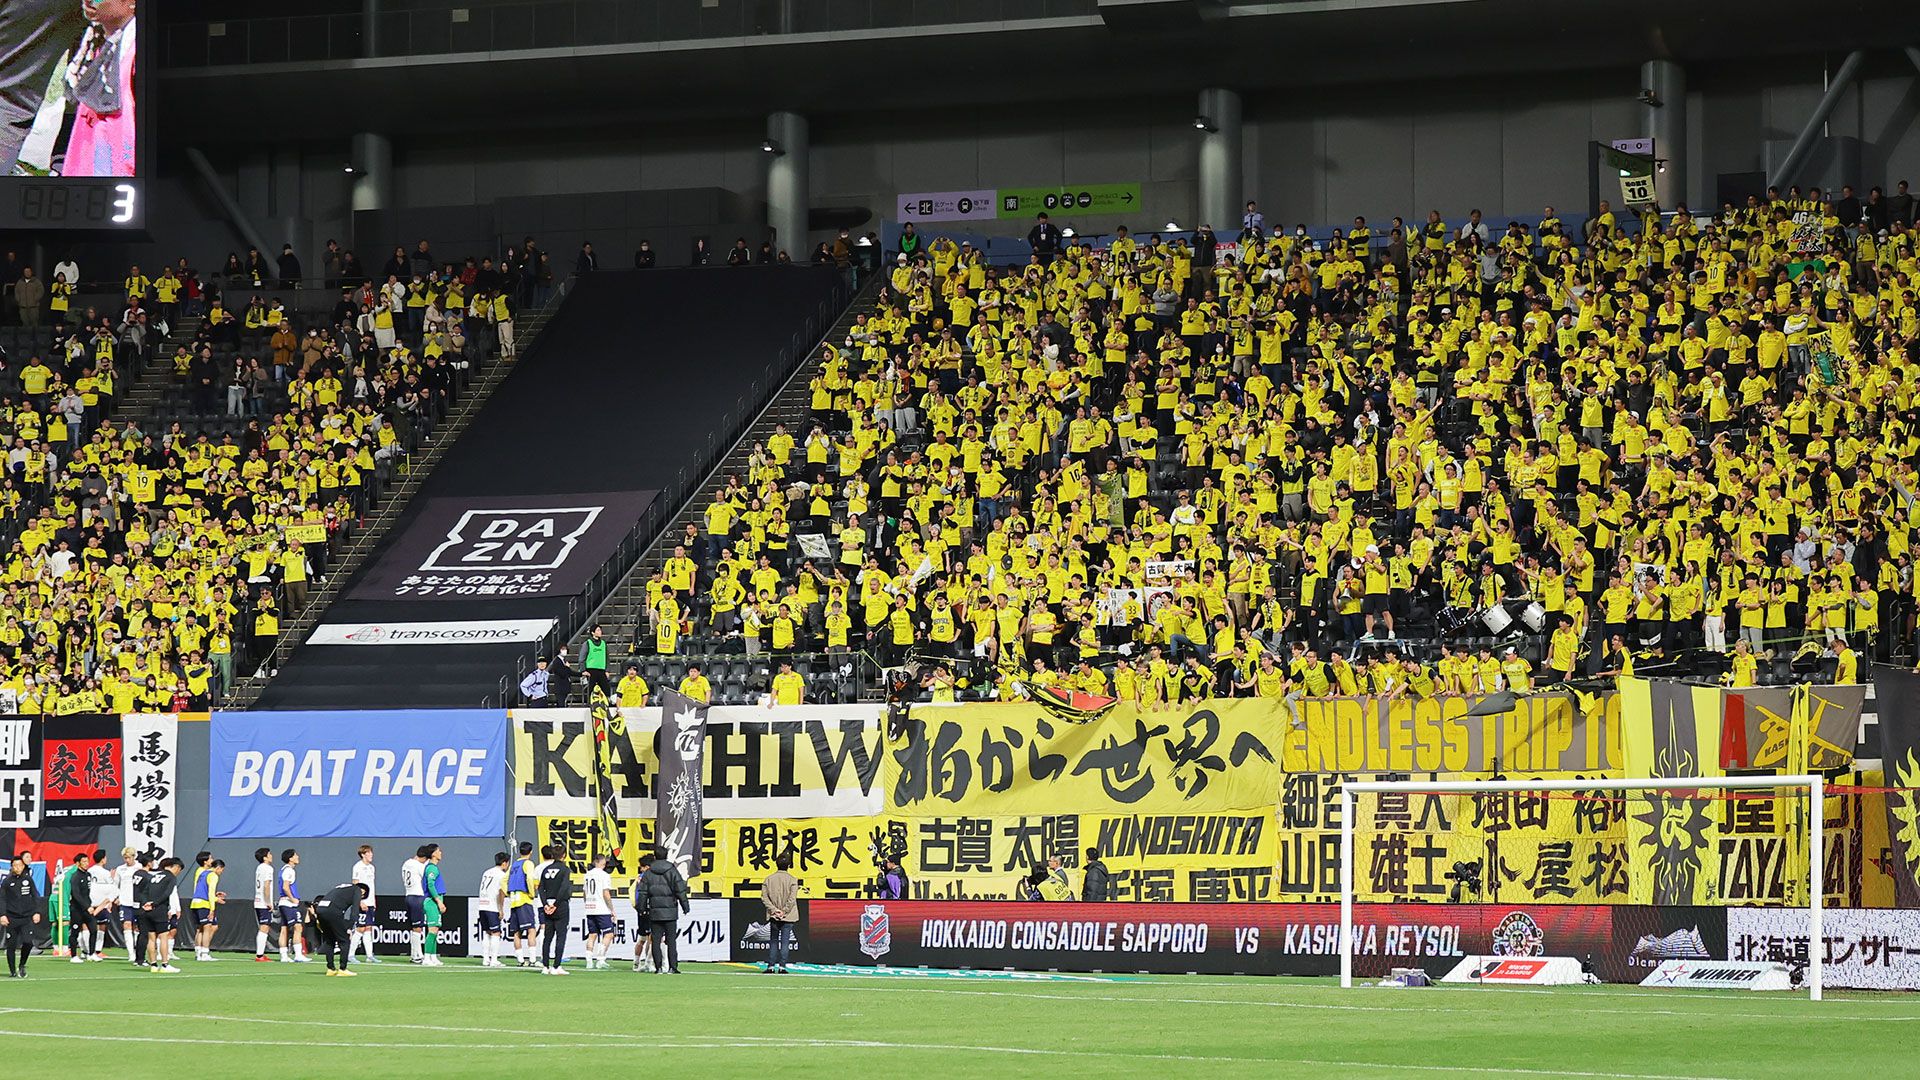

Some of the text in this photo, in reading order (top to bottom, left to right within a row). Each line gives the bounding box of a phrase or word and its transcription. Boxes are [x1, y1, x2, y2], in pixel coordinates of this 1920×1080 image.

[1628, 187, 1648, 199] 10
[112, 184, 135, 223] 3
[920, 201, 932, 213] 北
[1047, 197, 1055, 207] P
[1792, 211, 1808, 225] 46
[1710, 267, 1718, 279] 10
[137, 476, 148, 488] 19
[1069, 469, 1081, 483] 10
[401, 573, 551, 586] あなたの加入が
[395, 583, 551, 596] クラブの強化に!
[390, 627, 521, 640] transcosmos
[660, 624, 671, 638] 10
[1283, 696, 1469, 773] ENDLESS
[1475, 695, 1574, 771] TRIP
[524, 719, 884, 799] KAHIW
[229, 748, 487, 797] BOAT RACE
[46, 807, 120, 817] REI IEIZUMI
[920, 817, 993, 873] 古賀
[1097, 814, 1265, 864] KINOSHITA
[1280, 833, 1355, 893] 山田
[585, 879, 596, 895] 10
[921, 919, 1465, 957] HOKKAIDO CONSADOLE SAPPORO VS KASHWA REYSOL
[1688, 968, 1761, 981] WINNER
